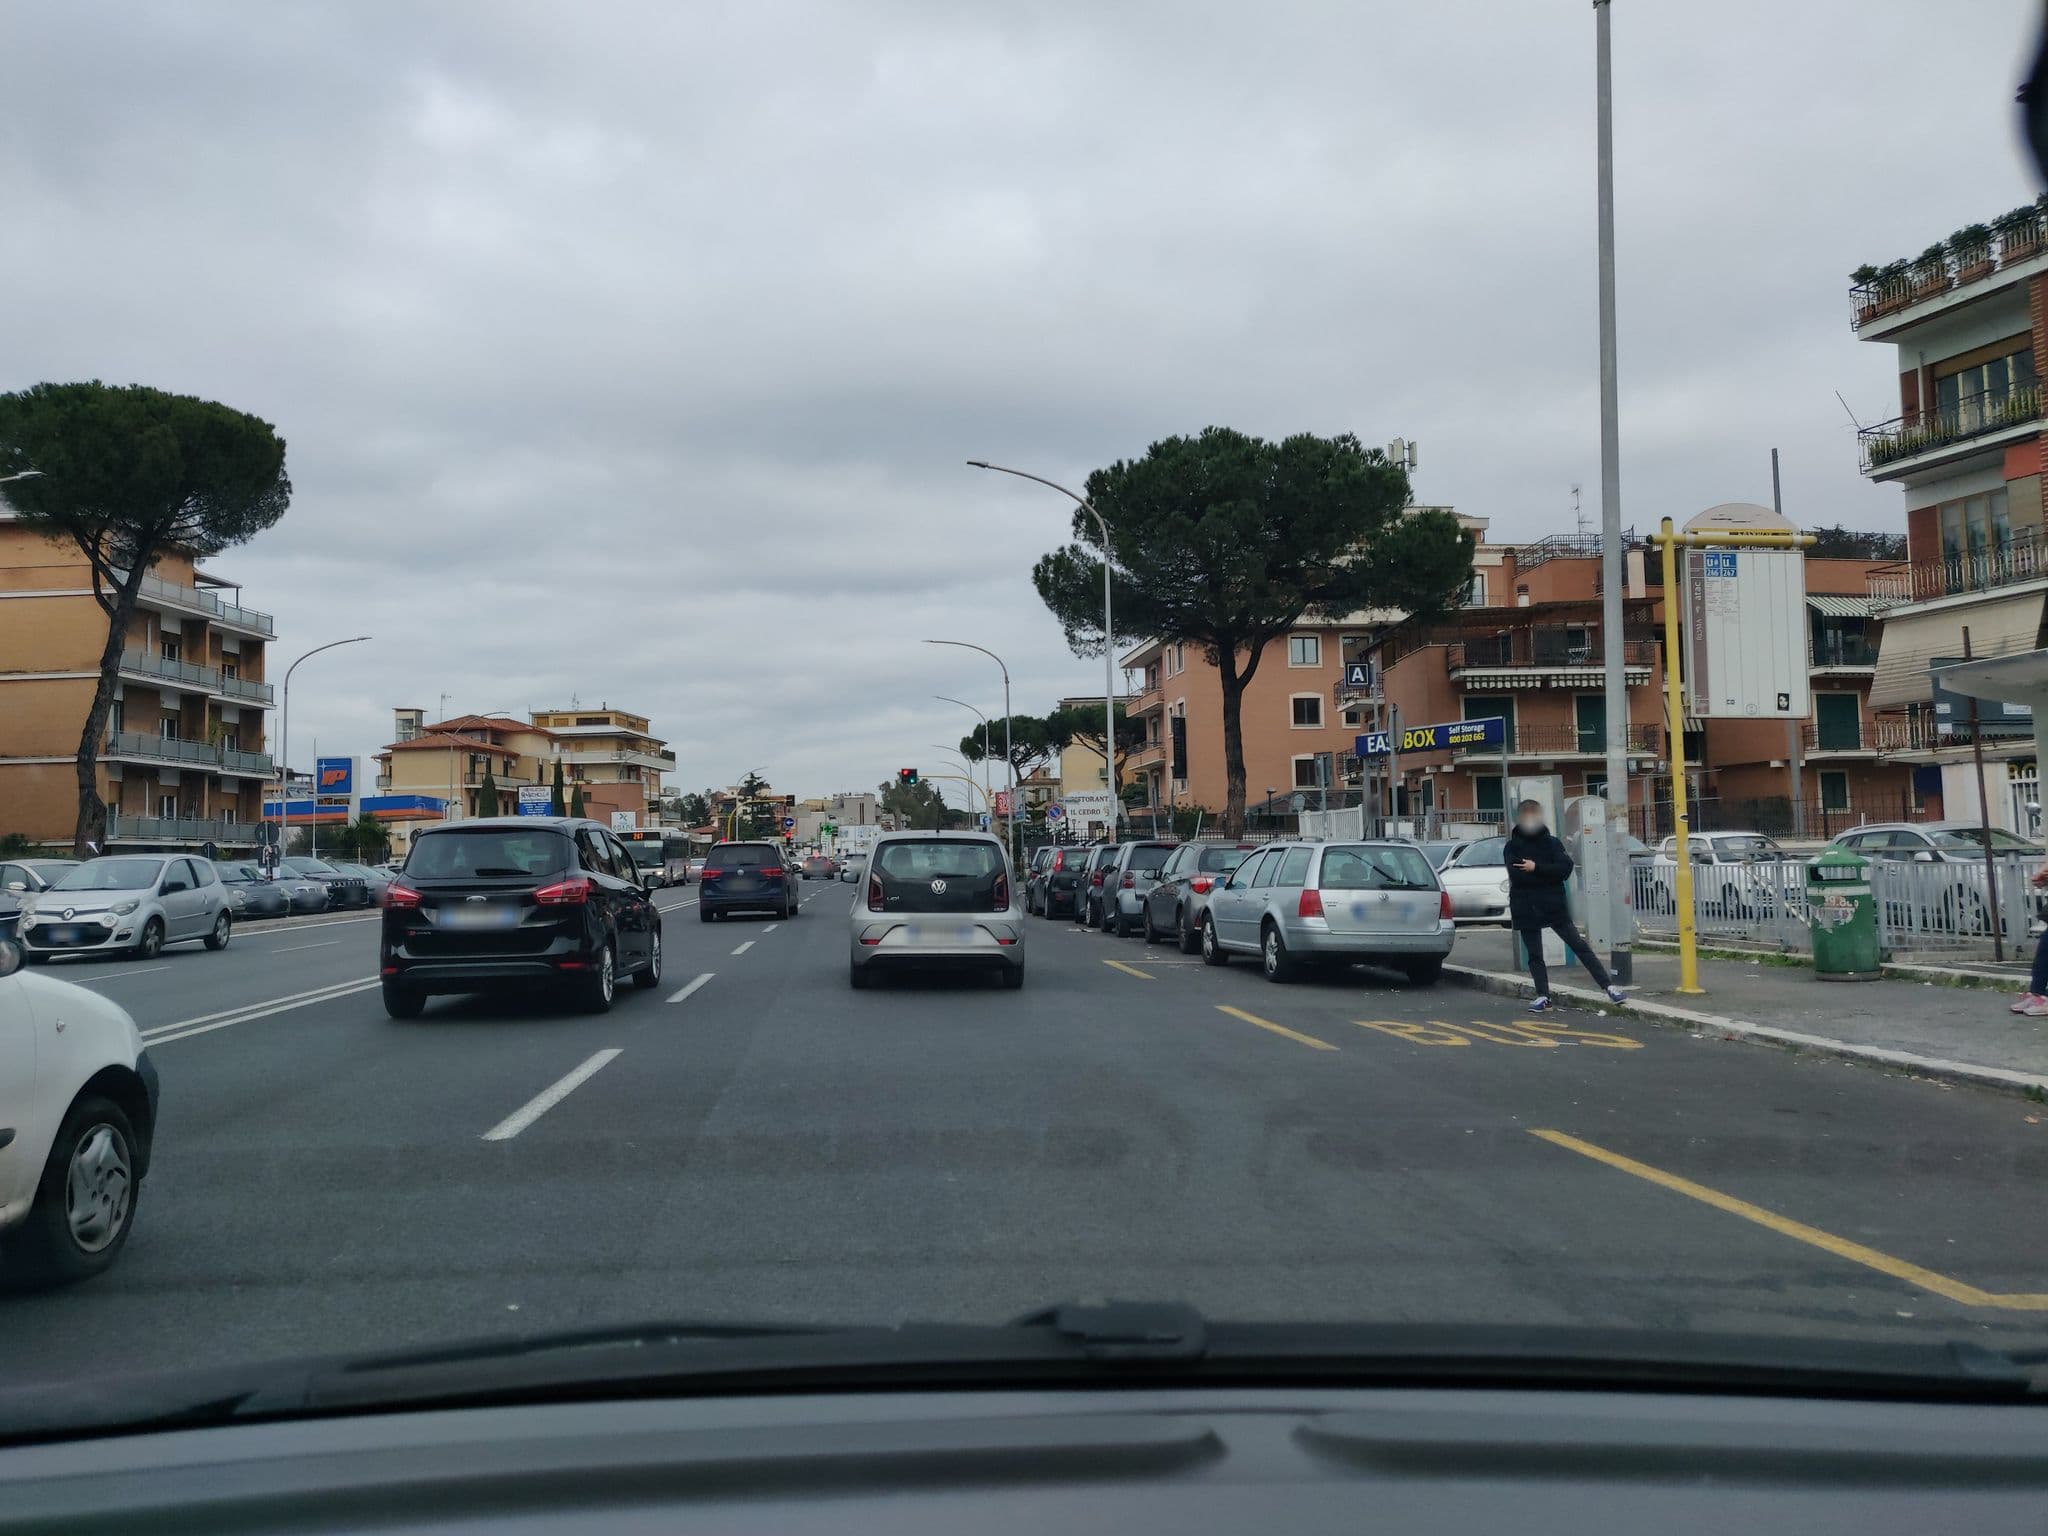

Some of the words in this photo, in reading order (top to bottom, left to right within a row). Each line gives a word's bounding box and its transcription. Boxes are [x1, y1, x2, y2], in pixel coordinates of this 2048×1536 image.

[1351, 666, 1365, 682] A
[1448, 725, 1461, 735] Self
[1461, 724, 1485, 734] Storage
[1078, 808, 1101, 816] CEDRO
[1352, 1019, 1645, 1049] BUS
